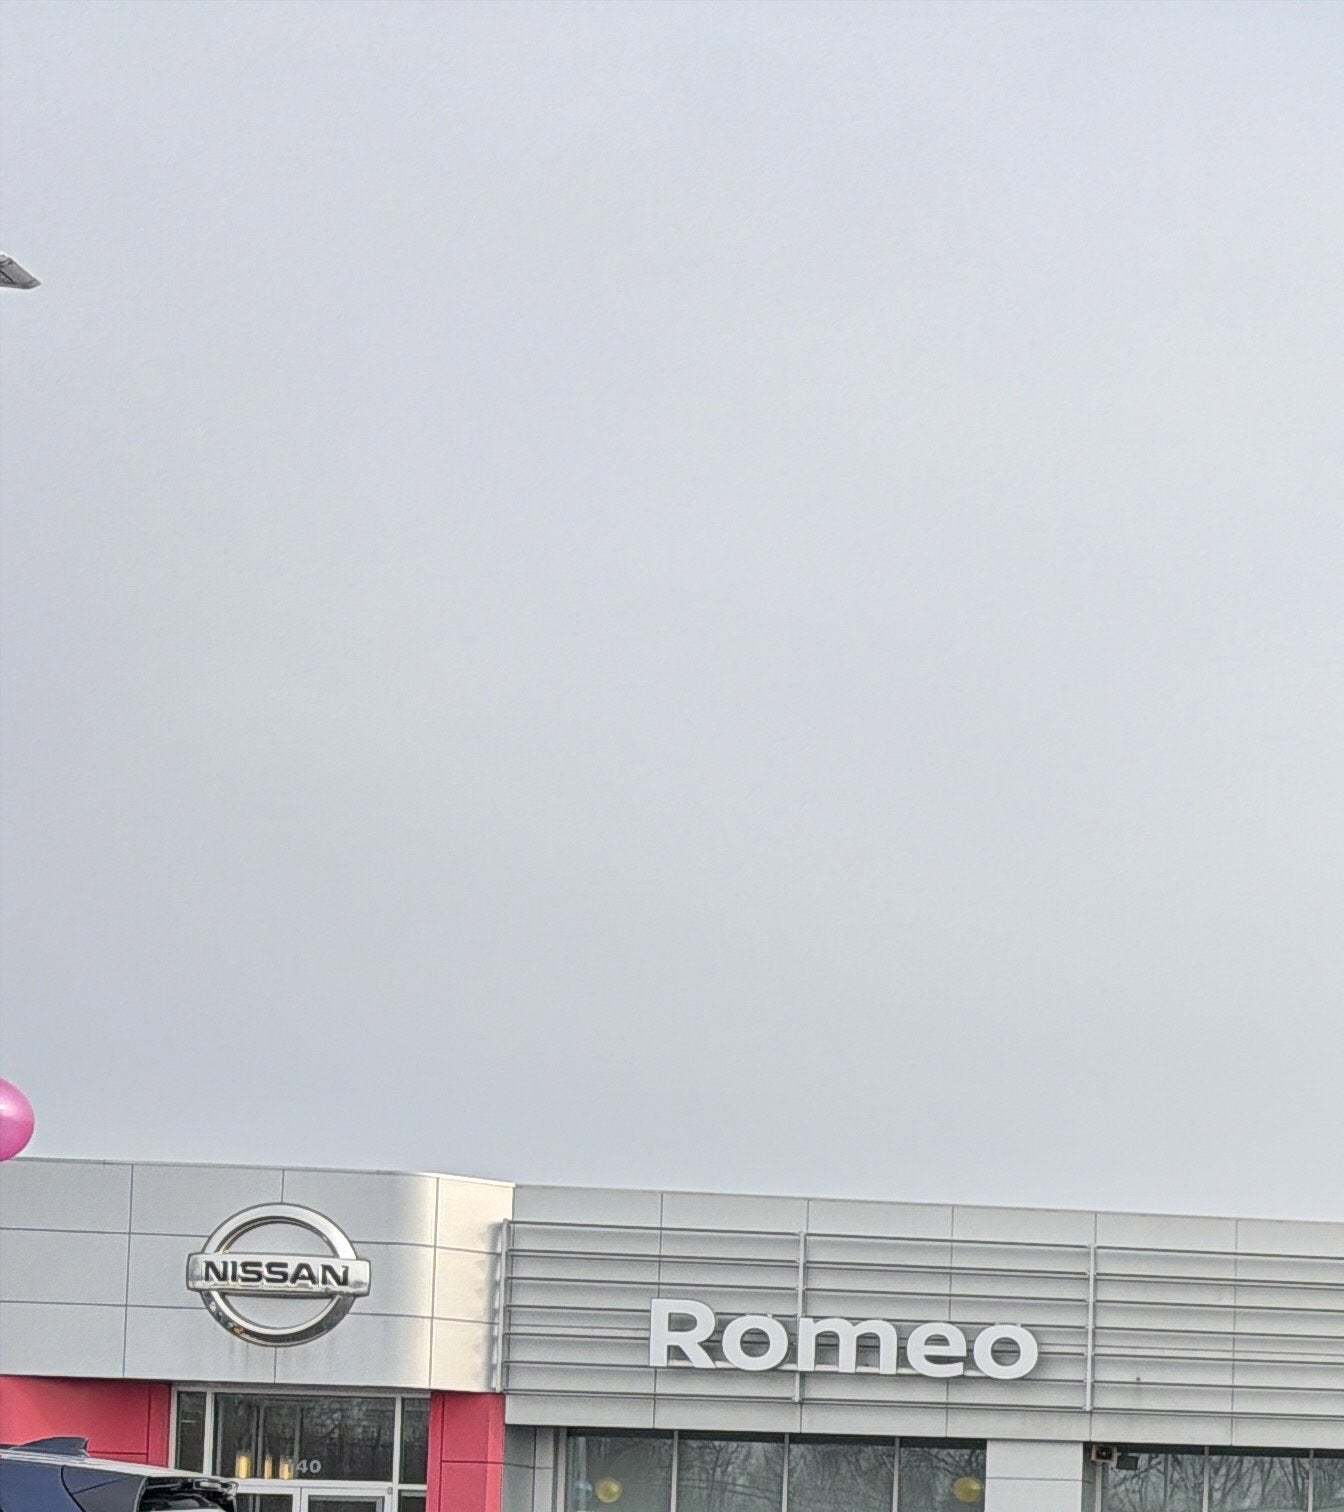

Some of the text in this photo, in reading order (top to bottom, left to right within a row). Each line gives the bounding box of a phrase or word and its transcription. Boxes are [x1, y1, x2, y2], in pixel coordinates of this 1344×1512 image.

[204, 1260, 349, 1286] NISSAN
[650, 1299, 1038, 1380] Romeo
[296, 1459, 322, 1473] 40
